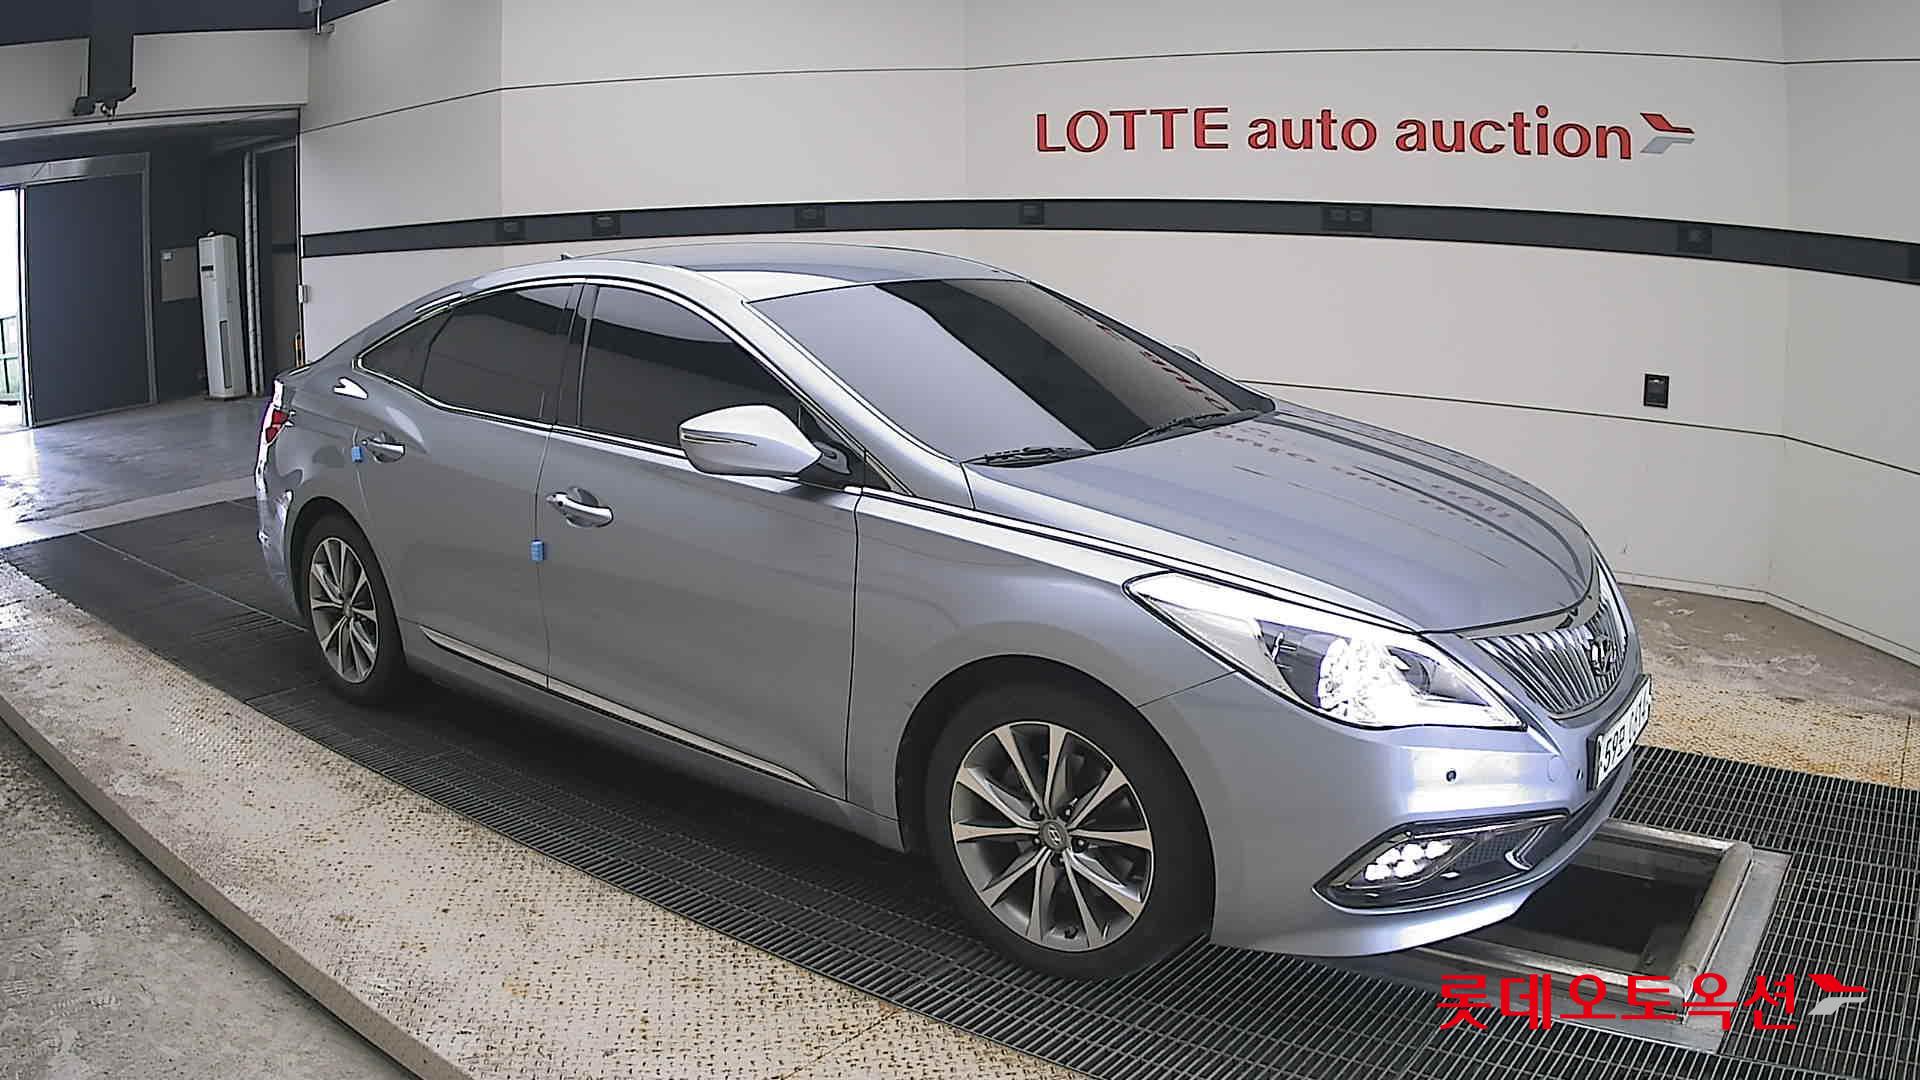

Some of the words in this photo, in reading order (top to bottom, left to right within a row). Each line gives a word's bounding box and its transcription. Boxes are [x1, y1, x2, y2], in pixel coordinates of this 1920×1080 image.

[1036, 106, 1229, 153] LOTTE
[1247, 108, 1378, 151] auto
[1394, 104, 1633, 160] auction
